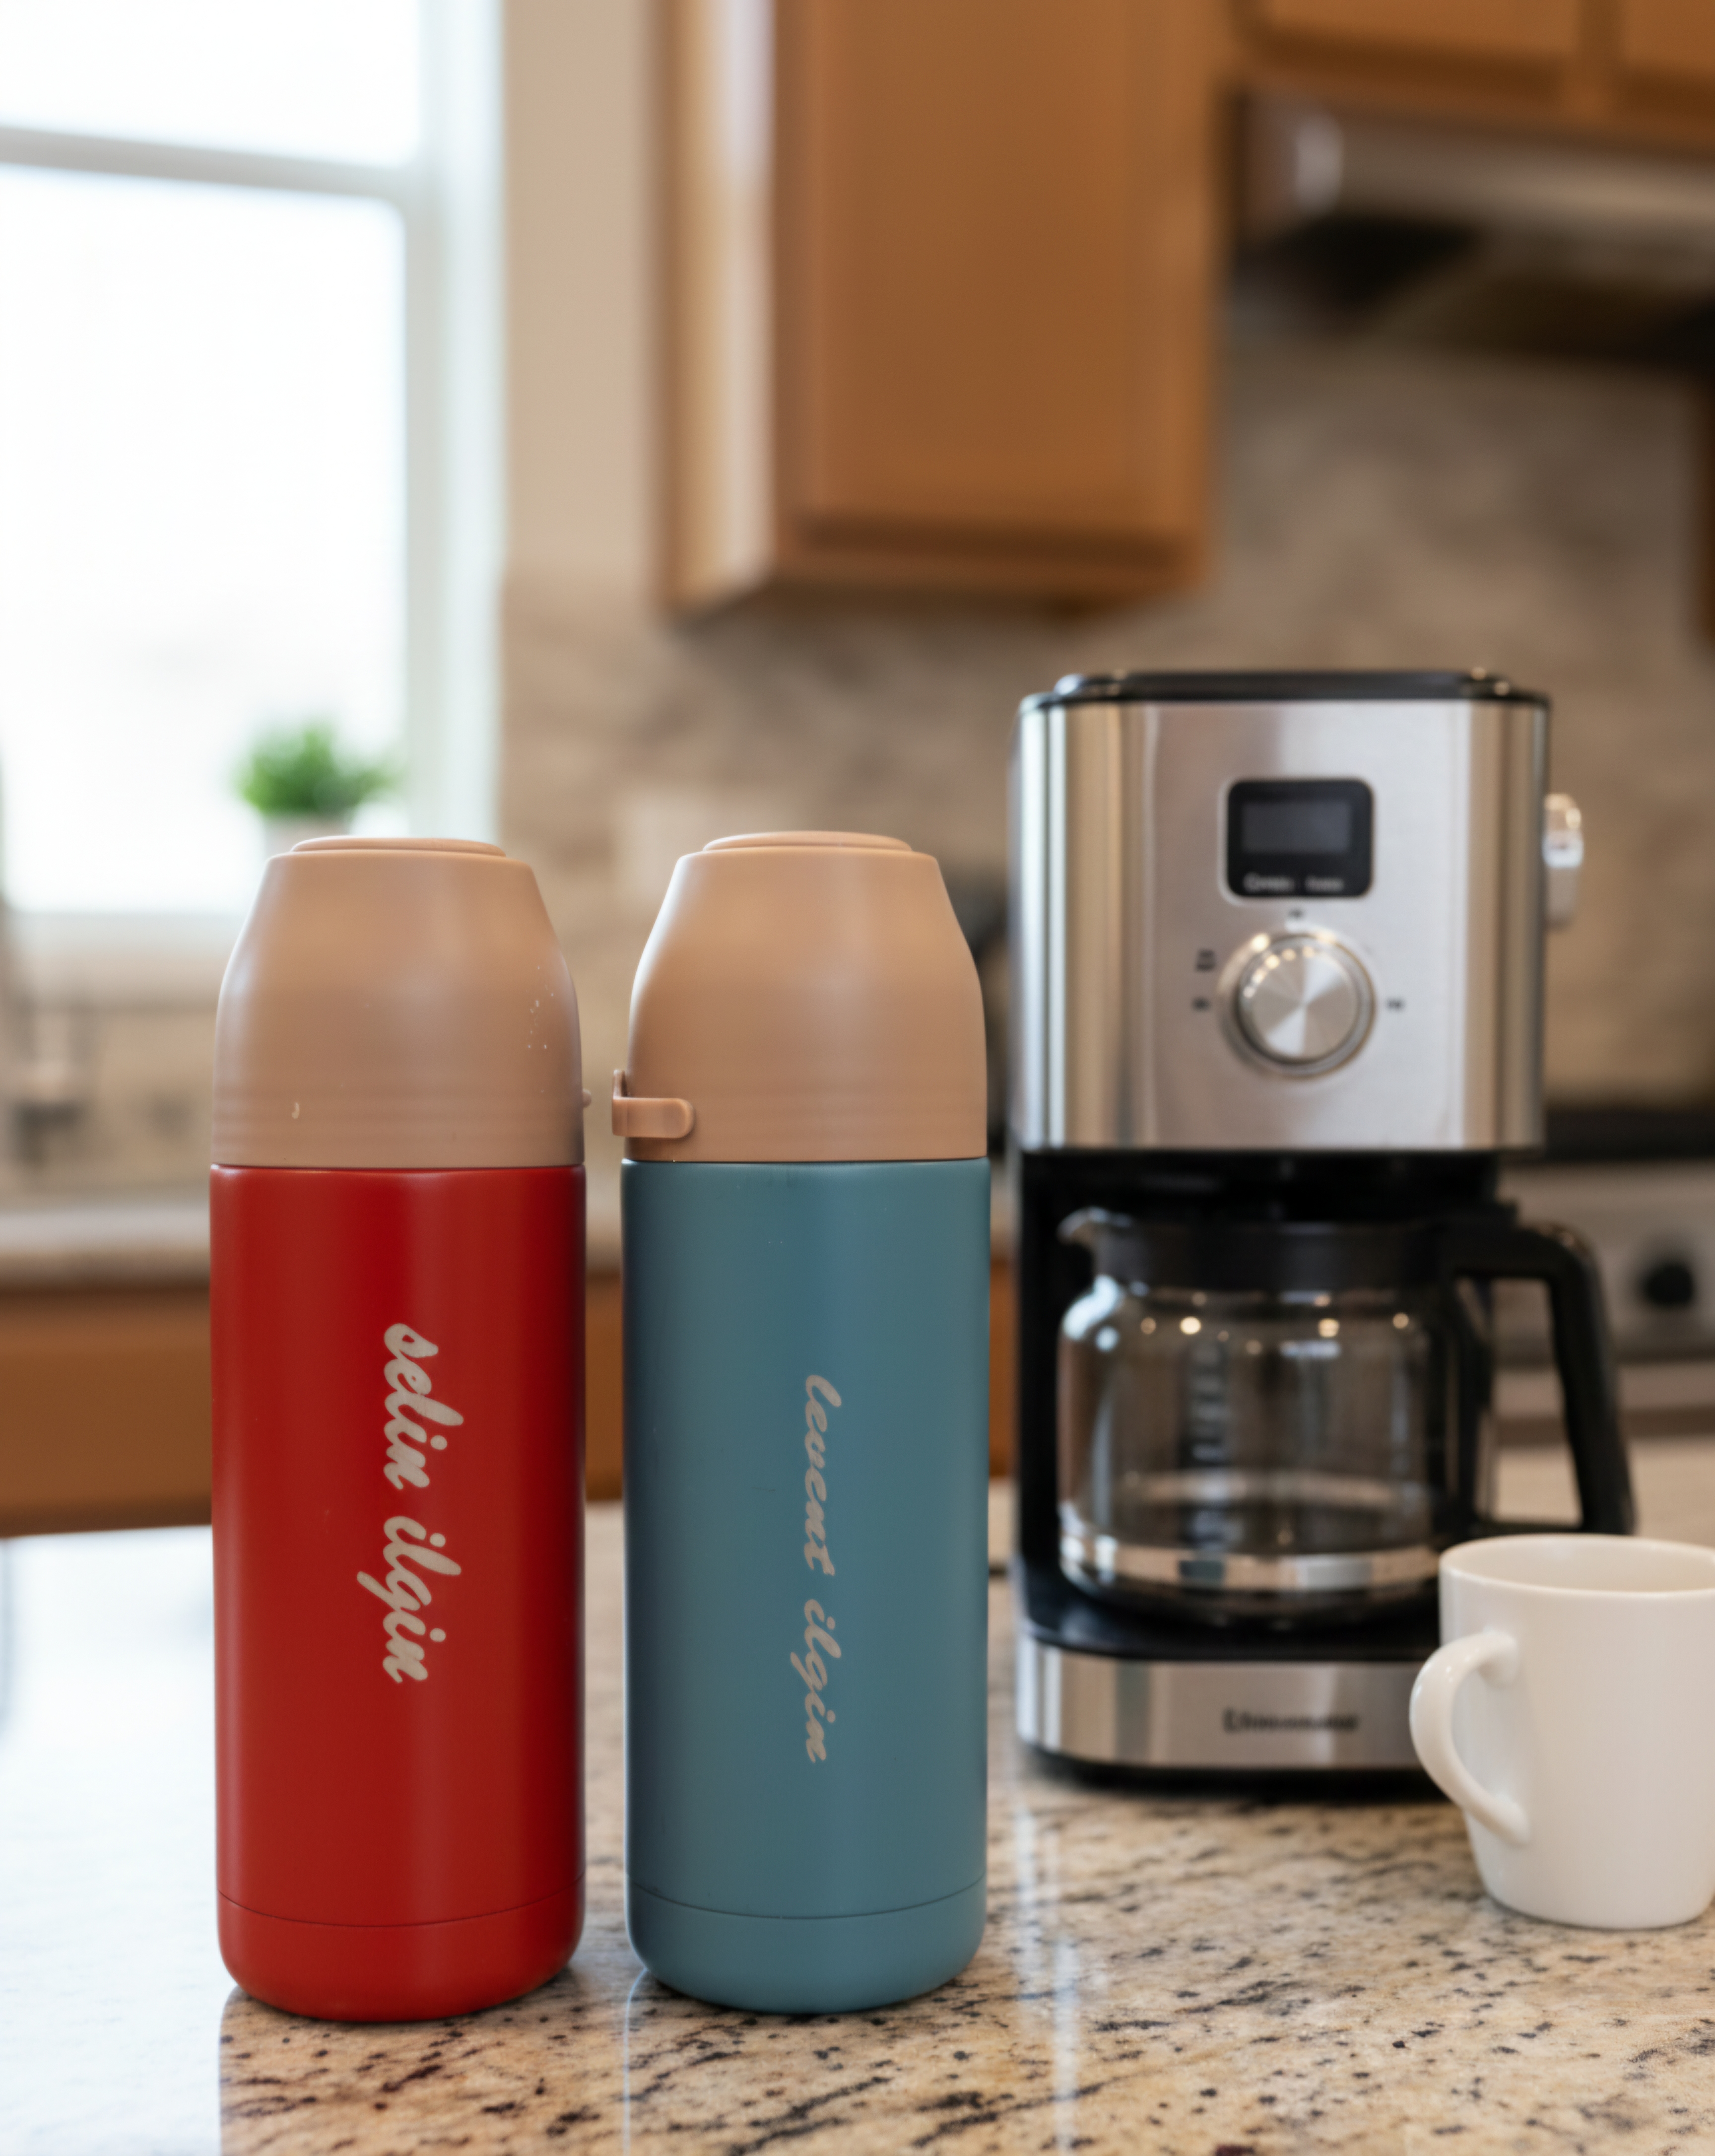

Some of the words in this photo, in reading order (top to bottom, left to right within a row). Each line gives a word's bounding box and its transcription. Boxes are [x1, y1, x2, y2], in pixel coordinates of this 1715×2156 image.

[384, 1323, 463, 1490] selin
[804, 1375, 842, 1576] levent
[357, 1516, 462, 1683] ilgin
[790, 1599, 842, 1762] ilgin
